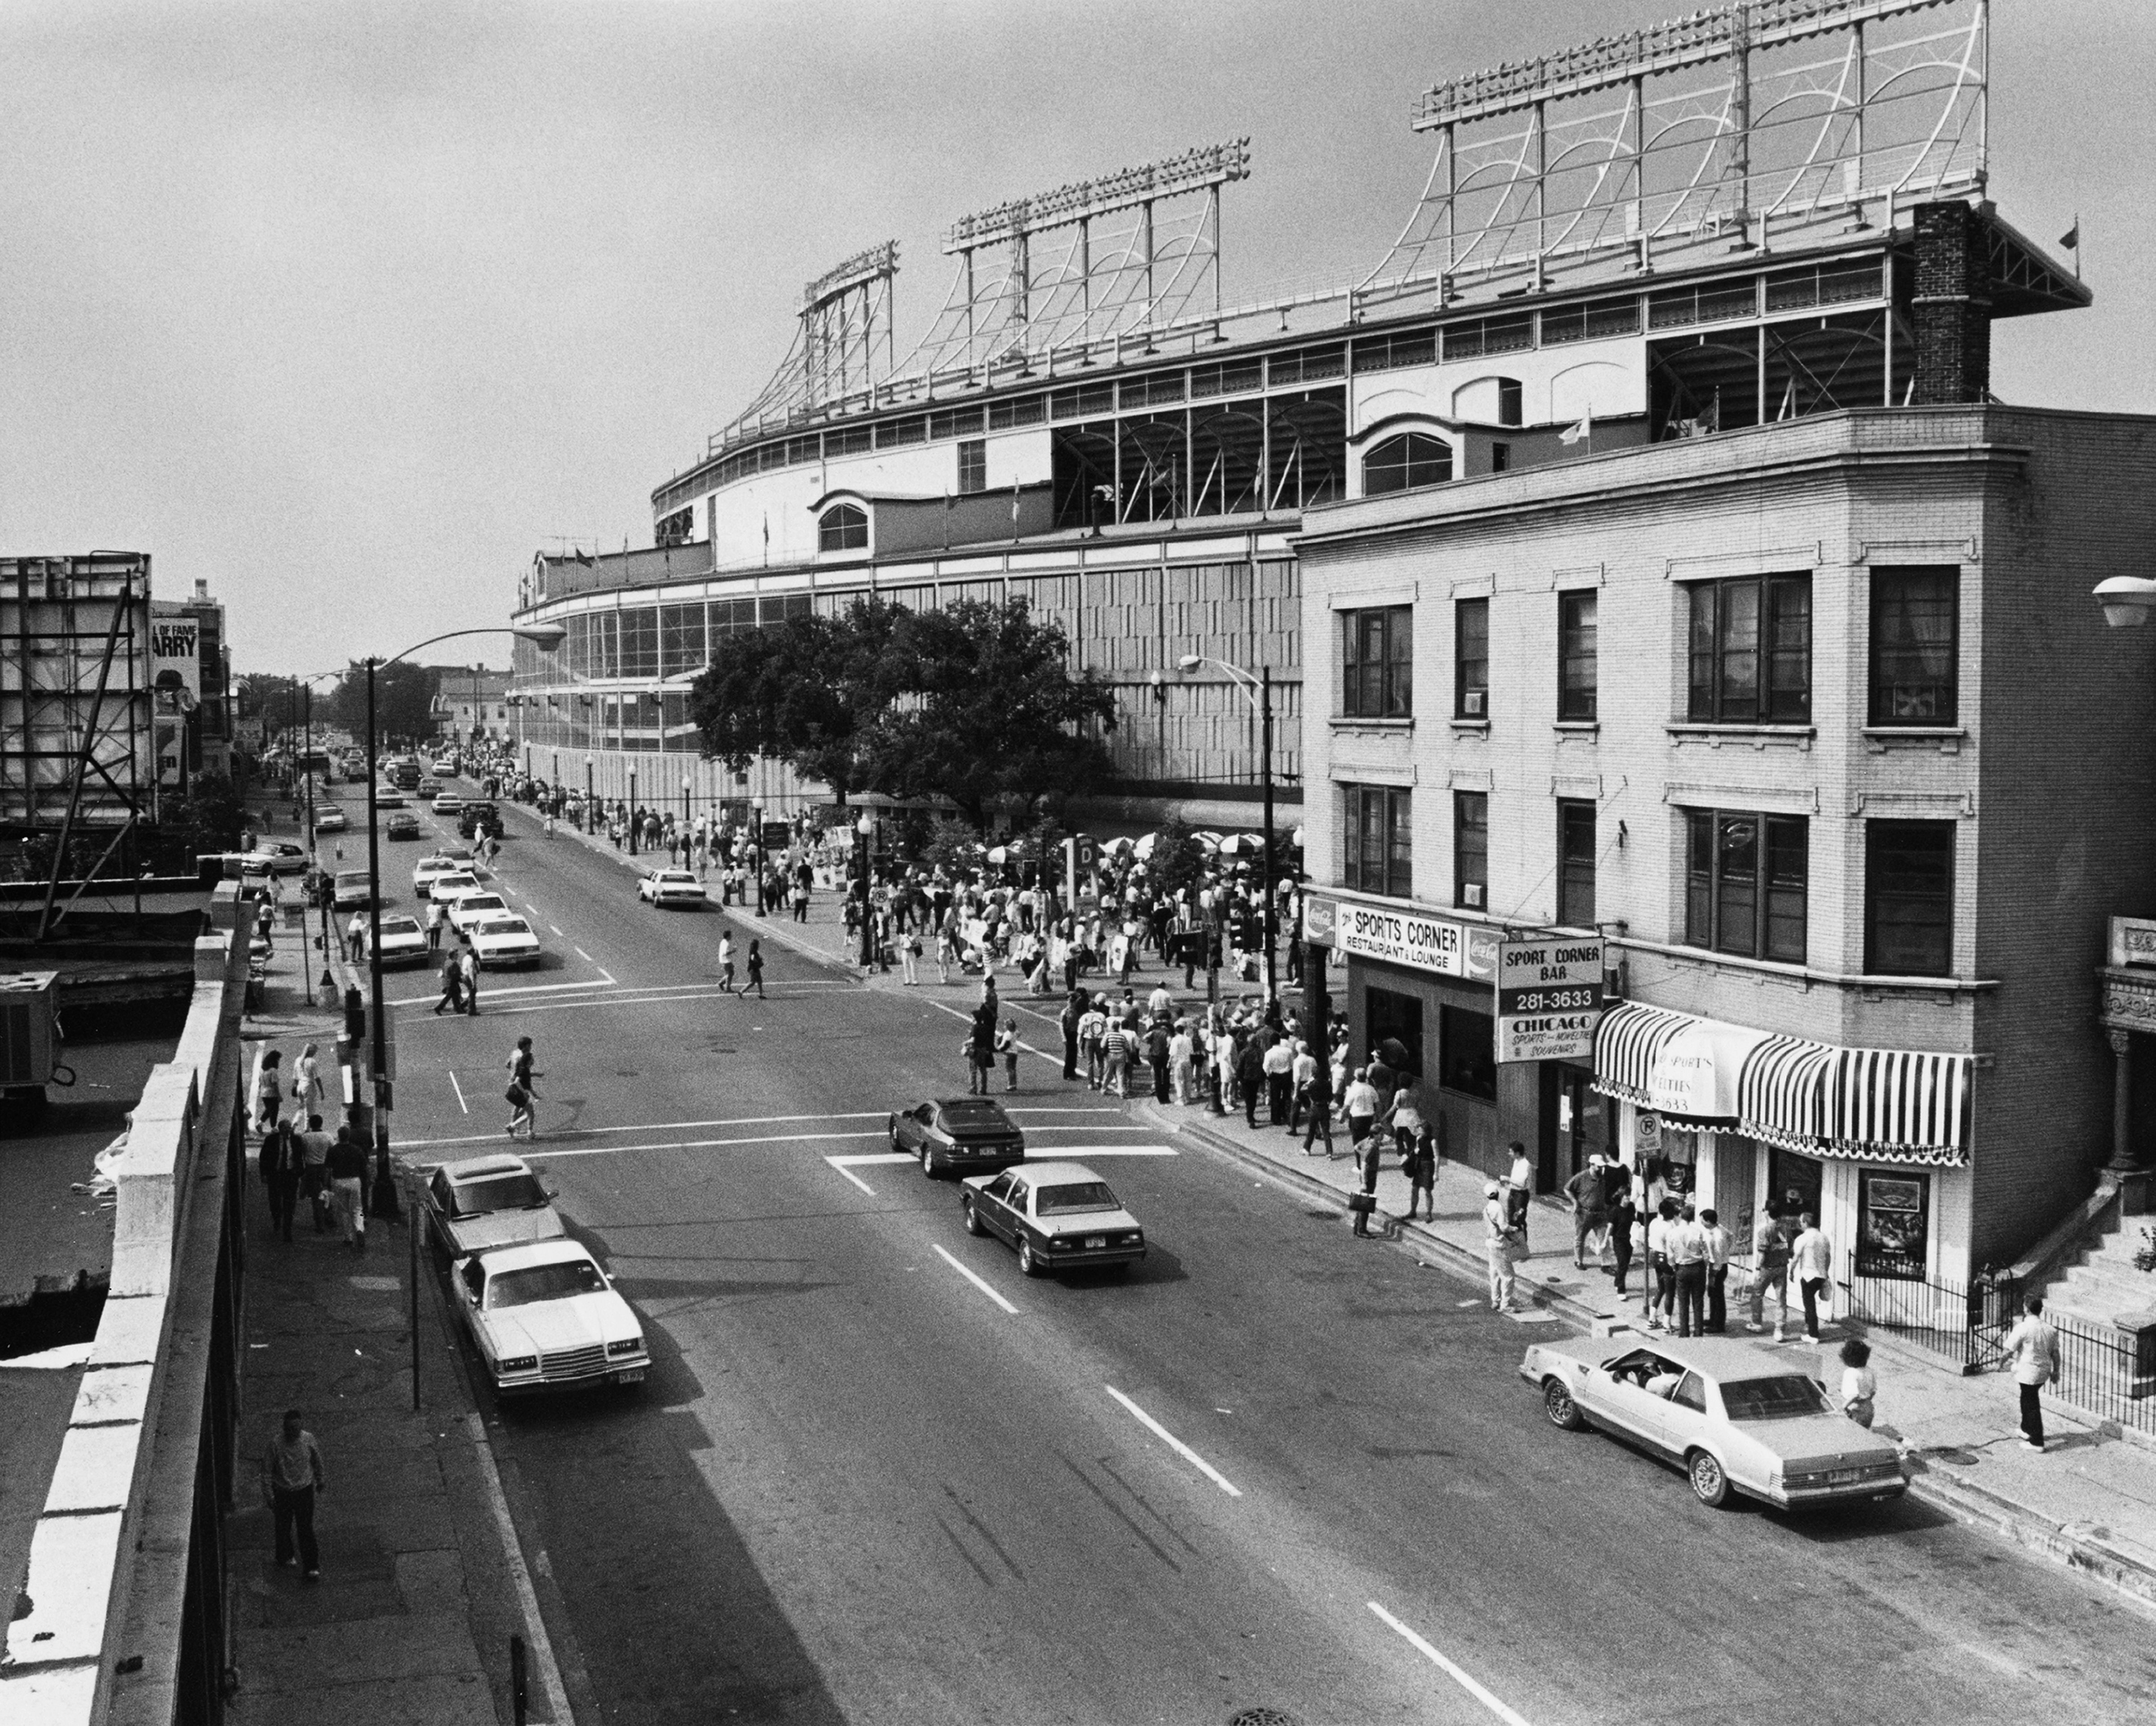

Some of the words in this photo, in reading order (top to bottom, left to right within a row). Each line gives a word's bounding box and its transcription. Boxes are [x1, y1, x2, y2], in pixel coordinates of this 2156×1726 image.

[159, 625, 170, 635] OF
[172, 625, 197, 635] FAME
[1081, 847, 1092, 864] D
[1356, 911, 1401, 942] SPORTS
[1408, 921, 1457, 953] CORNER
[1347, 936, 1404, 958] RESTAURANT
[1412, 949, 1449, 968] LOUNGE
[1506, 950, 1547, 966] SPORT
[1555, 946, 1600, 963] CORNER
[1540, 965, 1567, 981] BAR
[1517, 990, 1592, 1010] 281-3633
[1513, 1015, 1592, 1033] CHICAGO
[1512, 1032, 1547, 1045] SPORTS
